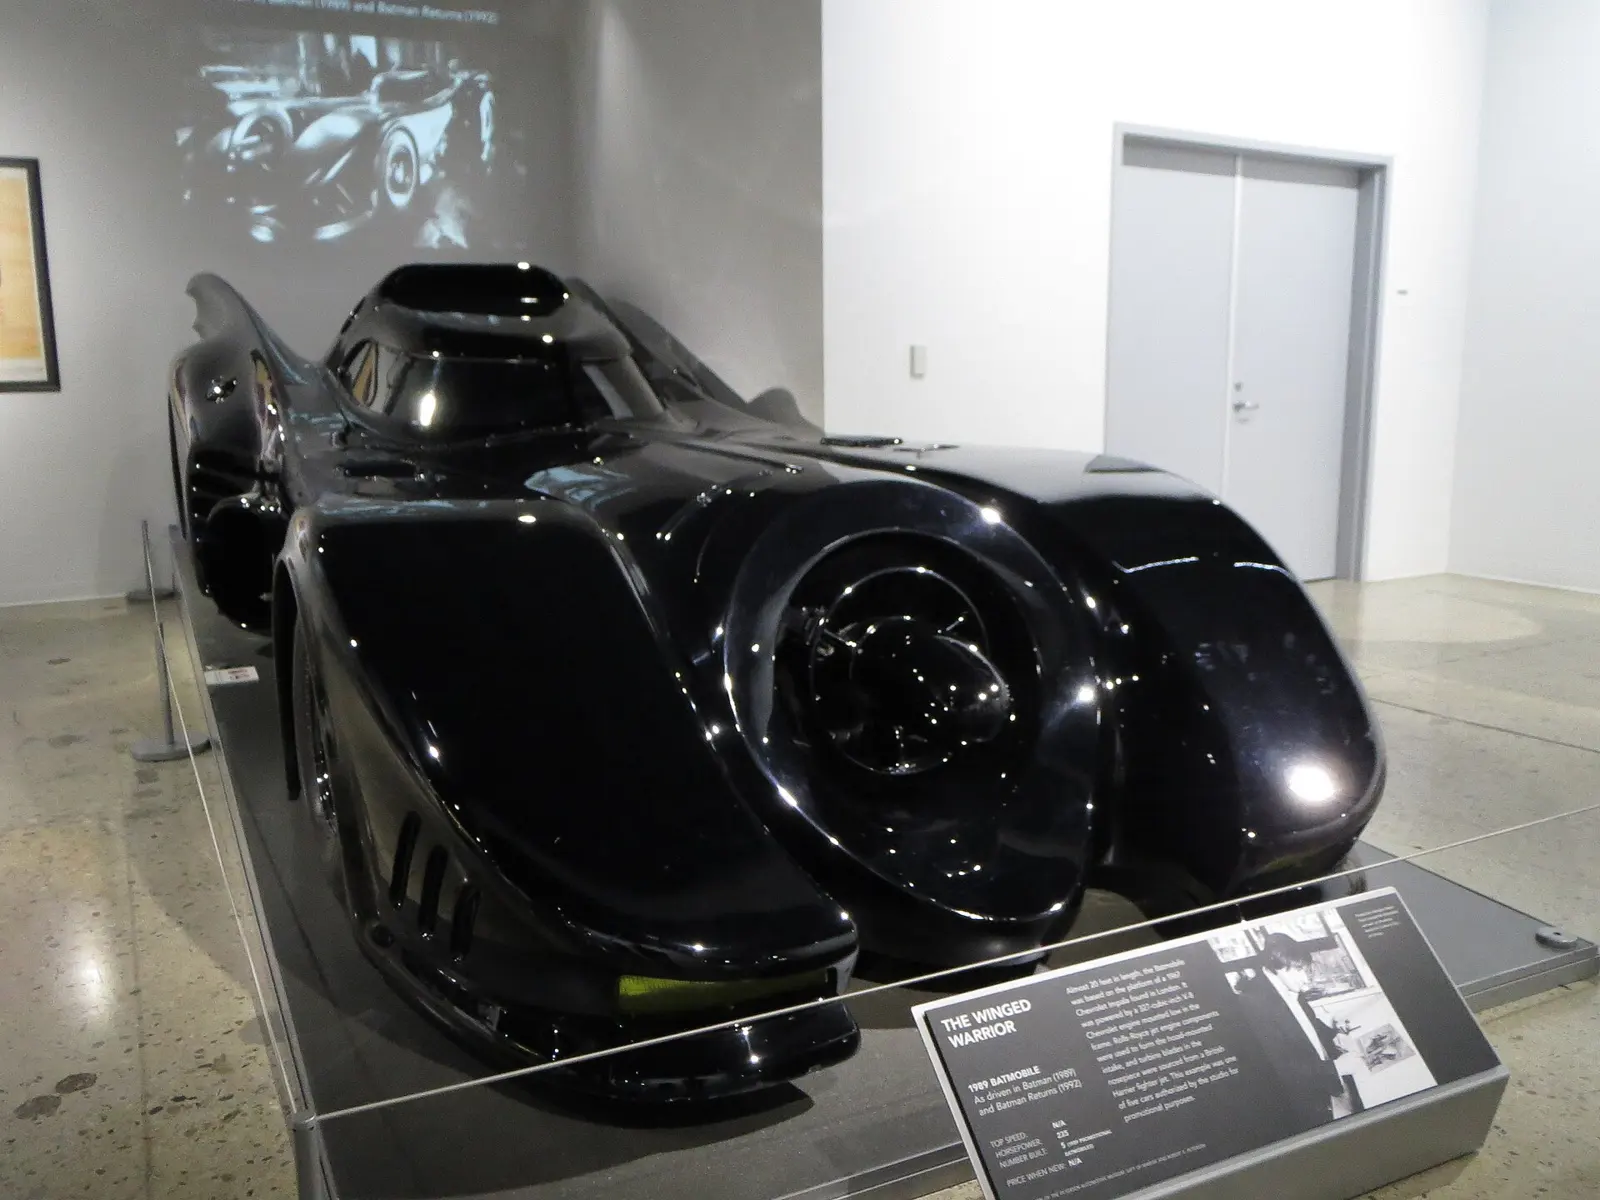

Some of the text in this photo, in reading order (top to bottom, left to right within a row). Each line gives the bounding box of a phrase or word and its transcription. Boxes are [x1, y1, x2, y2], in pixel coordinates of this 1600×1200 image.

[1127, 980, 1153, 992] platform
[941, 1000, 1031, 1031] THE WINGED
[1076, 1004, 1108, 1016] Chevrolet
[1129, 992, 1149, 1002] found
[1095, 1011, 1124, 1025] powered
[1123, 1009, 1133, 1017] by
[949, 1021, 1016, 1047] WARRIOR
[1086, 1026, 1118, 1039] Chevrolet
[1119, 1020, 1141, 1030] engine
[1141, 1011, 1170, 1023] mounted
[1160, 1022, 1181, 1031] engine
[1182, 1011, 1219, 1025] components
[1097, 1054, 1113, 1062] were
[1114, 1047, 1131, 1057] used
[1125, 1058, 1138, 1067] and
[1138, 1053, 1161, 1063] turbine
[1161, 1047, 1183, 1056] blades
[968, 1066, 1040, 1092] 1989 BATMOBILE
[1108, 1072, 1140, 1085] nosepiece
[1141, 1067, 1158, 1075] were
[1158, 1058, 1184, 1071] sourced
[1112, 1087, 1135, 1097] Harrier
[1136, 1080, 1158, 1091] fighter
[1185, 1064, 1211, 1075] example
[1225, 1056, 1237, 1064] one
[974, 1068, 1076, 1104] As driven in Batman (1989)
[979, 1079, 1082, 1116] and Batman Returns (1992)
[1118, 1101, 1126, 1109] of
[1140, 1095, 1154, 1103] cars
[1155, 1082, 1188, 1098] authorized
[1209, 1071, 1229, 1081] studio
[1124, 1096, 1195, 1123] promotional purposes.
[990, 1139, 1004, 1148] TOP
[1052, 1120, 1066, 1128] N/A
[1000, 1154, 1028, 1168] NUMBER
[1007, 1175, 1026, 1187] PRICE
[1026, 1168, 1048, 1180] WHEN
[1068, 1158, 1082, 1166] N/A
